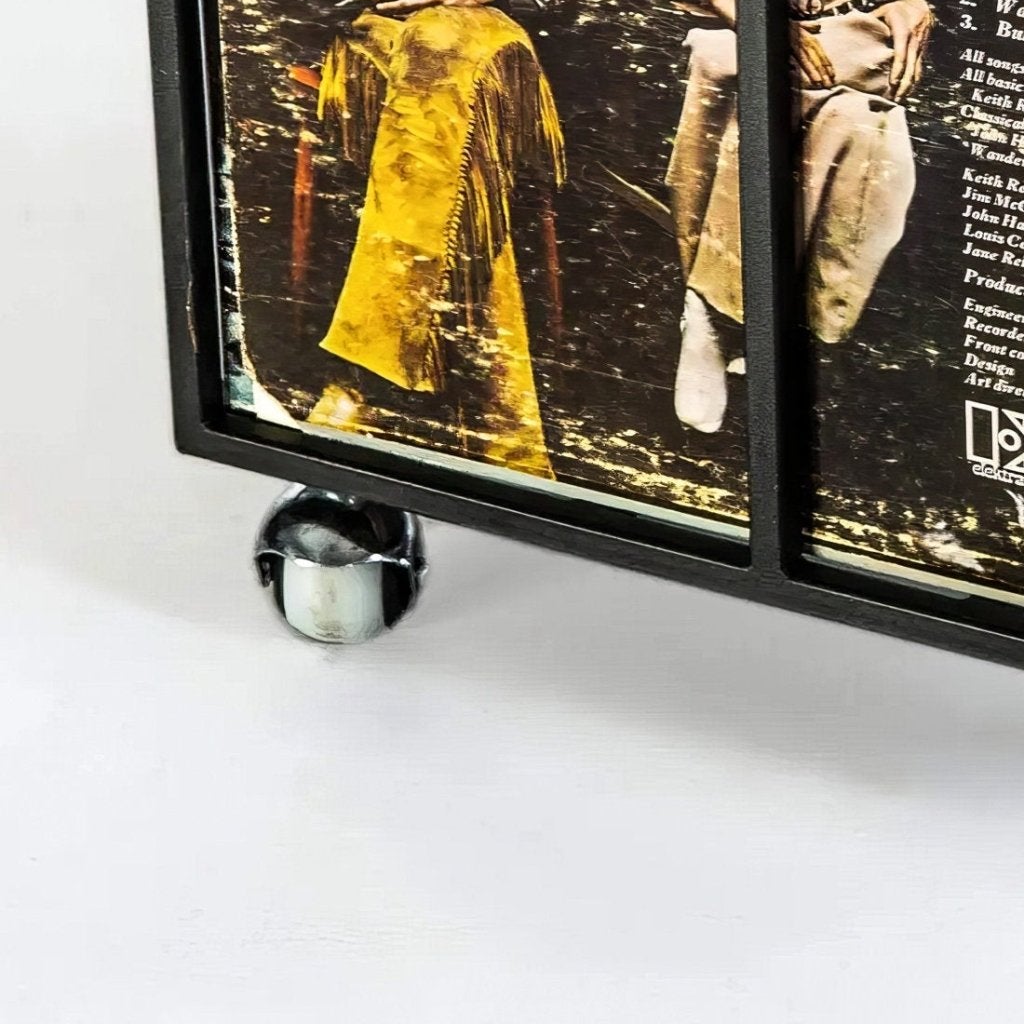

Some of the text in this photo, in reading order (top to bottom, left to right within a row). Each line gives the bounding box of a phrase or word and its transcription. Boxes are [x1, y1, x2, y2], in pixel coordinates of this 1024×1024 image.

[959, 14, 977, 30] 3.
[959, 48, 986, 64] All
[960, 67, 986, 83] All
[986, 72, 1024, 92] basic
[971, 88, 1013, 109] Keith
[962, 167, 1004, 188] Keith
[962, 186, 992, 204] Jim
[962, 205, 1000, 224] John
[963, 223, 1005, 244] Louis
[962, 242, 999, 261] Jane
[963, 334, 1008, 355] Front
[963, 352, 1016, 377] Design
[963, 372, 992, 388] Art
